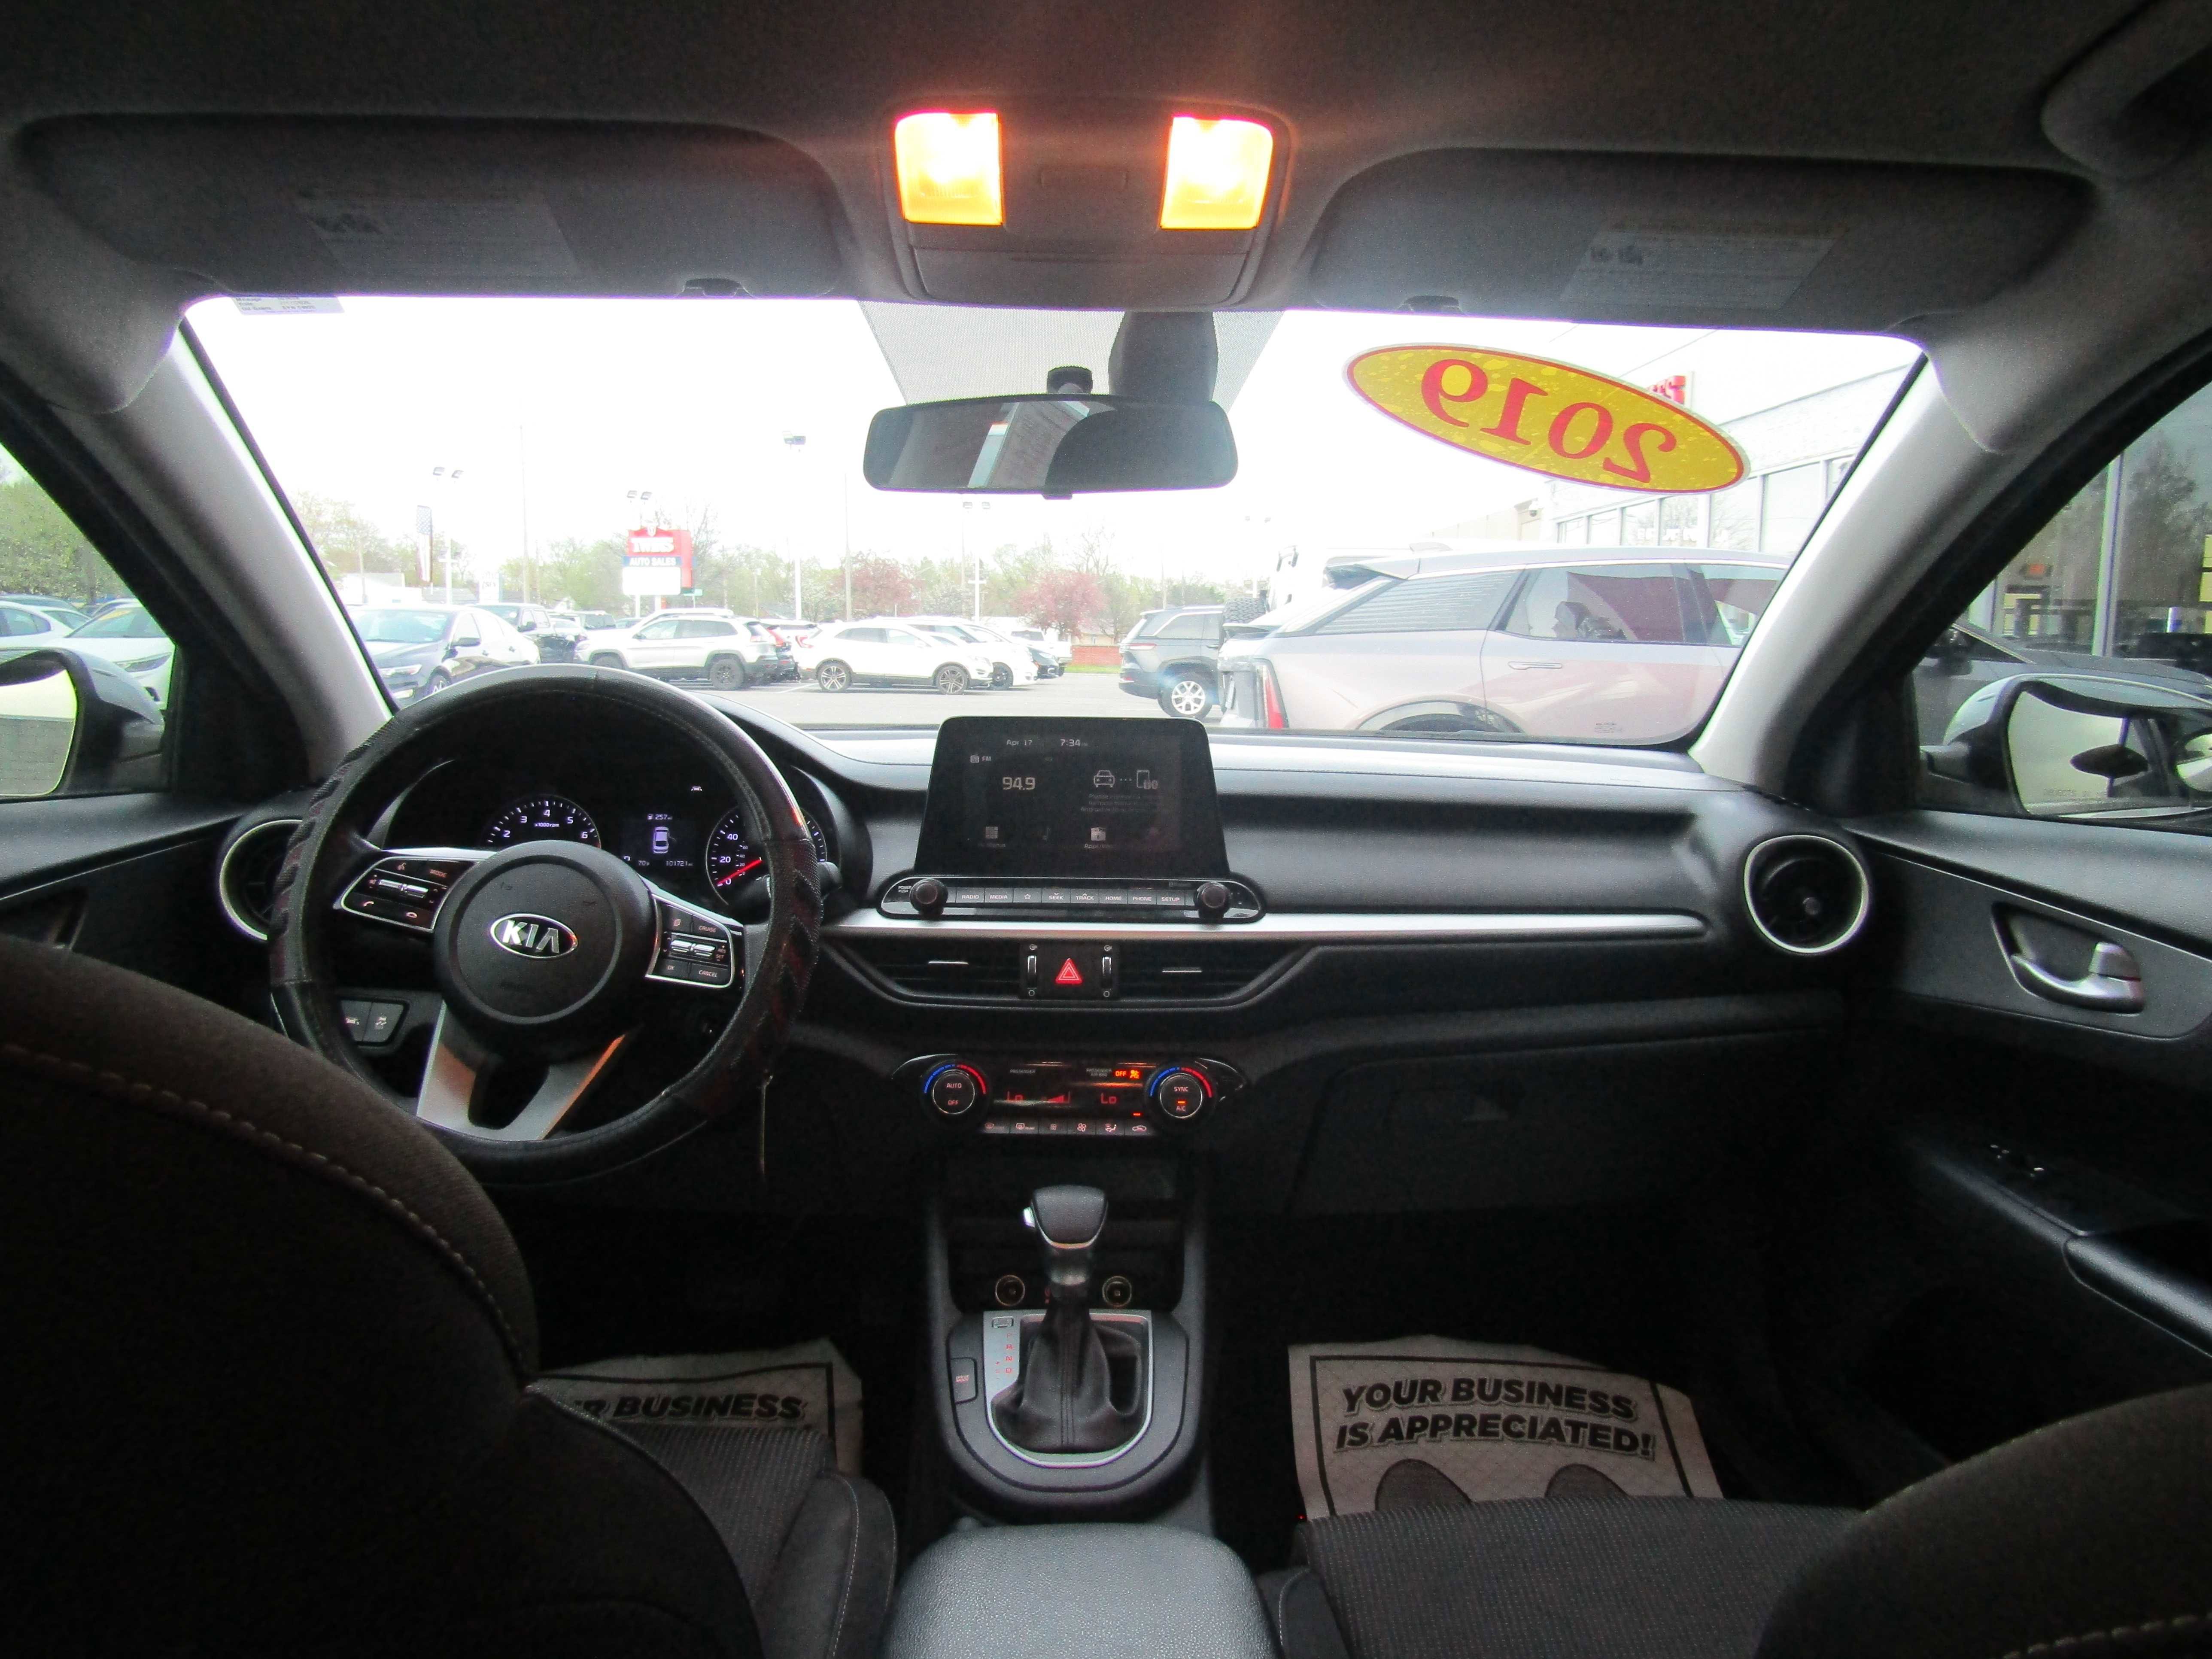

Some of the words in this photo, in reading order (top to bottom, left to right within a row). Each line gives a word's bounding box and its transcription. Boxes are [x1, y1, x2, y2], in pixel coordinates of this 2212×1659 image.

[629, 557, 650, 566] AUTO
[651, 557, 676, 566] SALES
[1002, 777, 1036, 790] 94.9
[501, 919, 560, 954] KIA
[612, 1393, 805, 1420] BUSINESS
[1342, 1377, 1443, 1415] YOUR
[1450, 1376, 1637, 1420] BUSINESS
[1334, 1422, 1372, 1450] IS
[1377, 1413, 1653, 1456] APPRECIATED!
